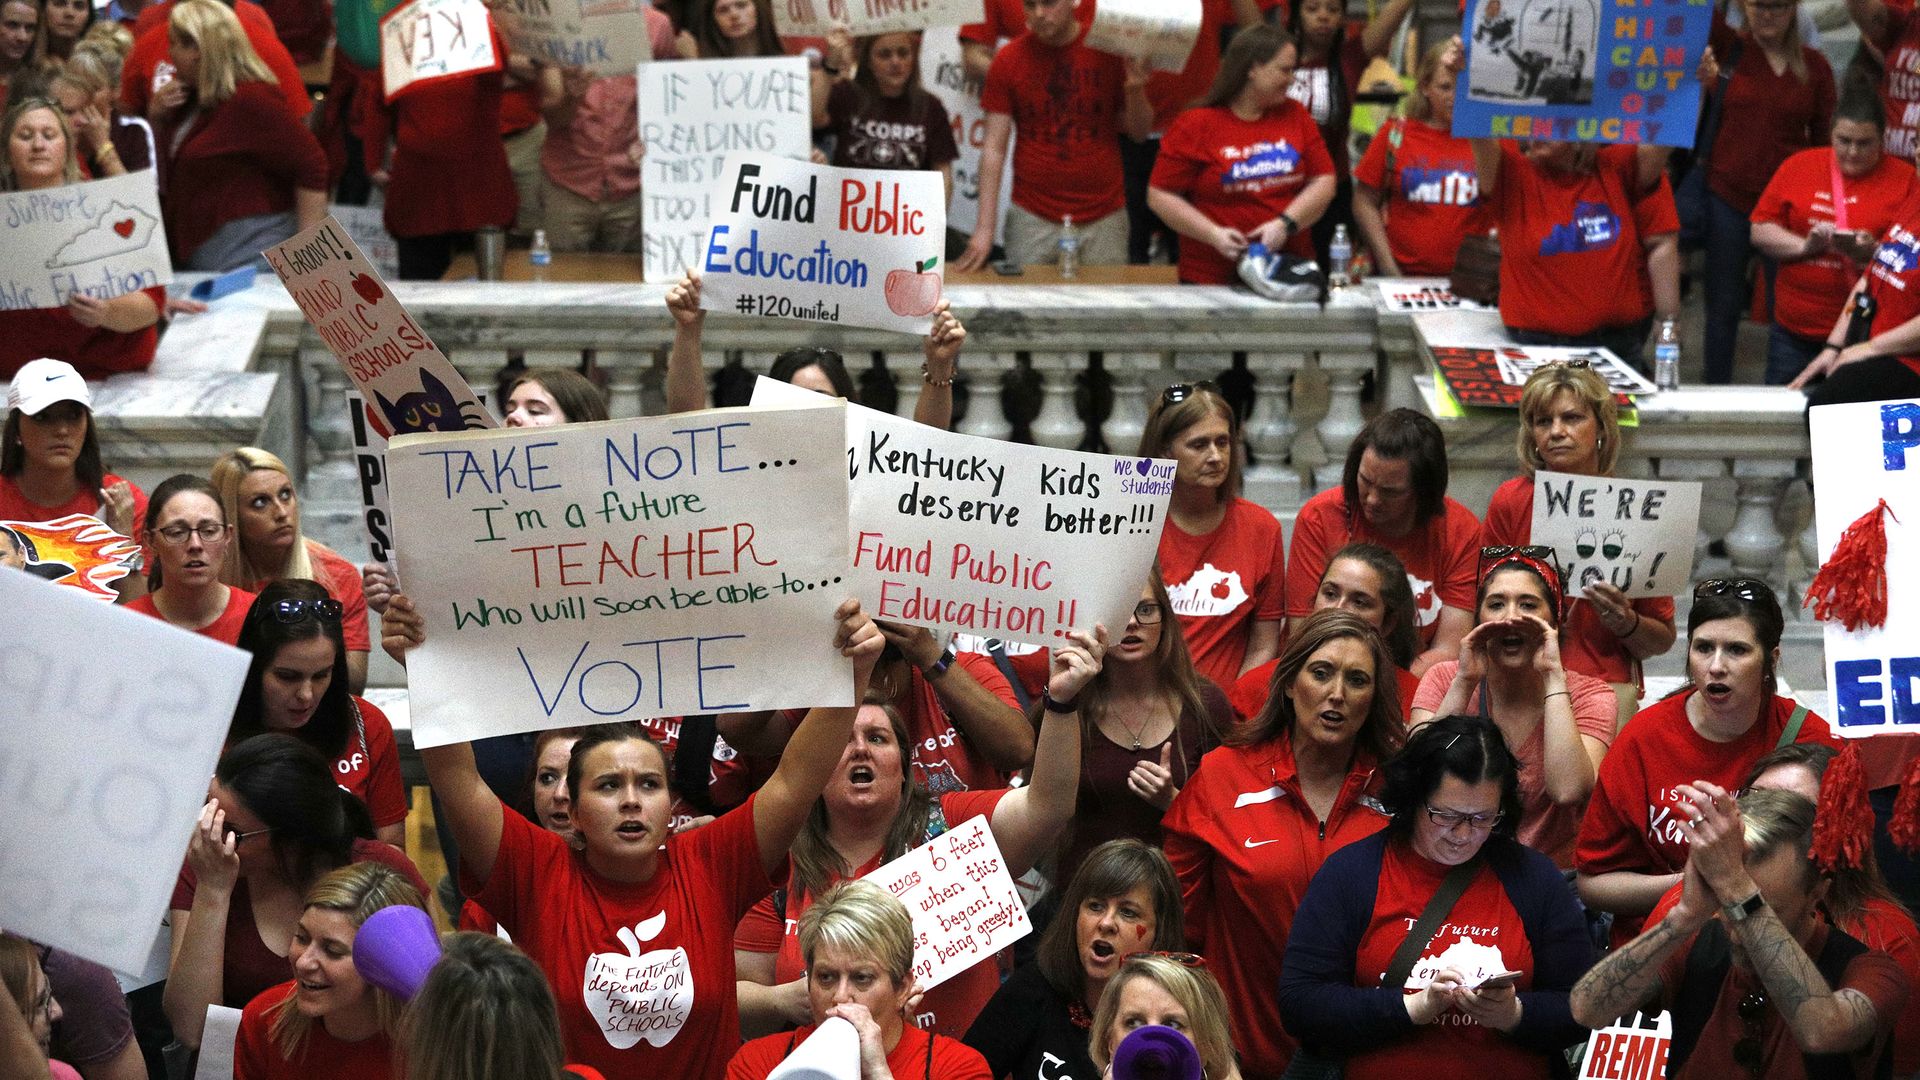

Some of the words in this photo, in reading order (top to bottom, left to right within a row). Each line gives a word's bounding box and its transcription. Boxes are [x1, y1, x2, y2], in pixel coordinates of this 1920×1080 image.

[1610, 46, 1685, 67] CAN
[663, 72, 690, 116] IF
[1608, 71, 1685, 91] OUT
[643, 118, 777, 155] READING
[1491, 115, 1663, 143] KENTUCKY
[651, 193, 697, 222] TOO
[730, 163, 818, 224] Fund
[838, 178, 925, 237] Public
[280, 225, 353, 276] GROOVY!
[705, 225, 868, 288] Education
[294, 279, 344, 324] FUND
[735, 293, 840, 322] #120united
[319, 302, 379, 357] PUBLIC
[348, 313, 434, 383] SCHOOLS!
[418, 441, 562, 499] TAKE
[868, 430, 1005, 498] Kentucky
[1040, 461, 1100, 499] Kids
[1151, 464, 1175, 480] our
[472, 499, 548, 543] I'm
[565, 503, 587, 529] a
[595, 491, 707, 523] future
[898, 481, 1020, 528] deserve
[1543, 480, 1668, 521] WE'RE
[510, 522, 778, 588] TEACHER
[853, 531, 932, 577] Fund
[452, 597, 523, 630] Who
[530, 596, 586, 623] will
[670, 587, 712, 609] be
[716, 582, 769, 605] able
[516, 634, 751, 716] VOTE
[938, 727, 957, 748] of
[337, 752, 363, 774] of
[888, 870, 922, 894] was
[949, 826, 984, 860] feet
[919, 886, 965, 912] when
[966, 858, 999, 883] this
[933, 934, 978, 965] being
[977, 890, 1023, 946] greedy!
[936, 885, 994, 932] began!
[1434, 922, 1499, 938] future
[588, 974, 658, 1001] depends
[663, 970, 685, 990] ON
[625, 951, 682, 981] FUTURE
[605, 1011, 684, 1032] SCHOOLS
[608, 993, 682, 1015] PUBLIC
